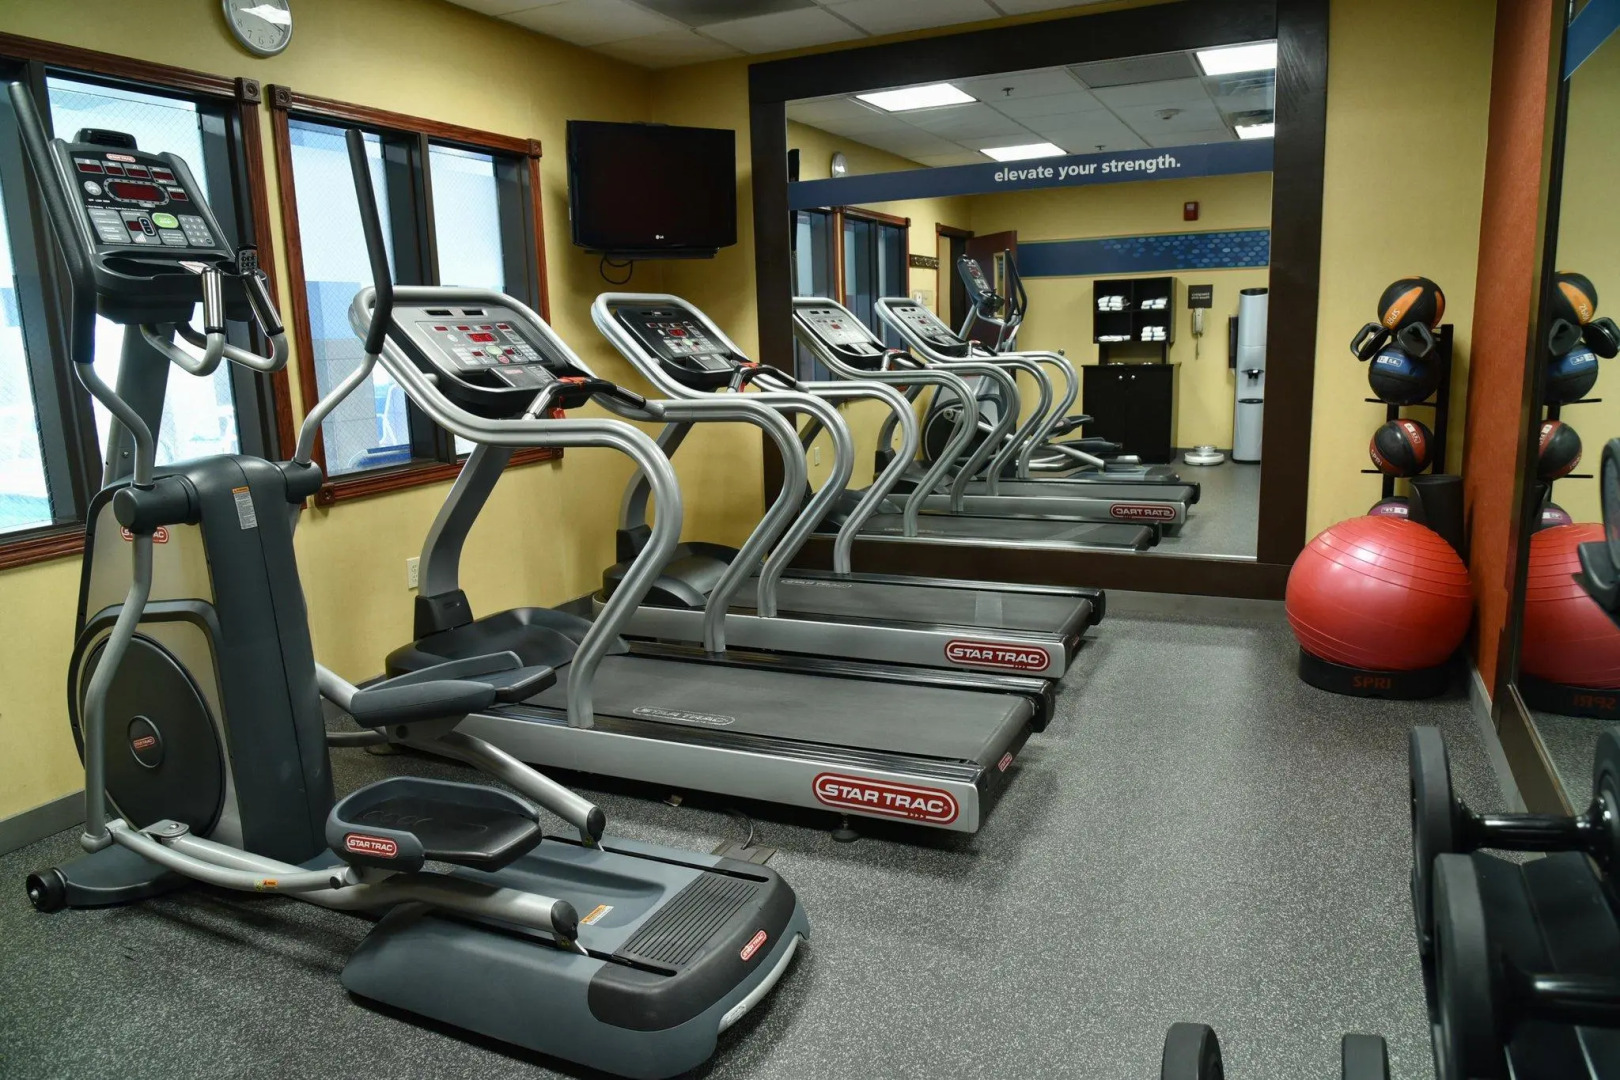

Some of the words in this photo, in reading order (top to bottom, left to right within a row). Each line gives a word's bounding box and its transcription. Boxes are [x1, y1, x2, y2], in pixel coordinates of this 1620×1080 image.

[247, 29, 253, 39] 7
[268, 34, 275, 44] 5
[994, 167, 1054, 182] elevate
[1058, 163, 1098, 180] your
[1101, 153, 1181, 174] strength.
[953, 647, 994, 660] STAR
[996, 651, 1041, 664] TRAC
[1352, 675, 1391, 689] SPRI
[824, 783, 879, 803] STAR
[883, 792, 944, 813] TRAC
[349, 839, 371, 848] STAR
[371, 841, 393, 851] TRAC
